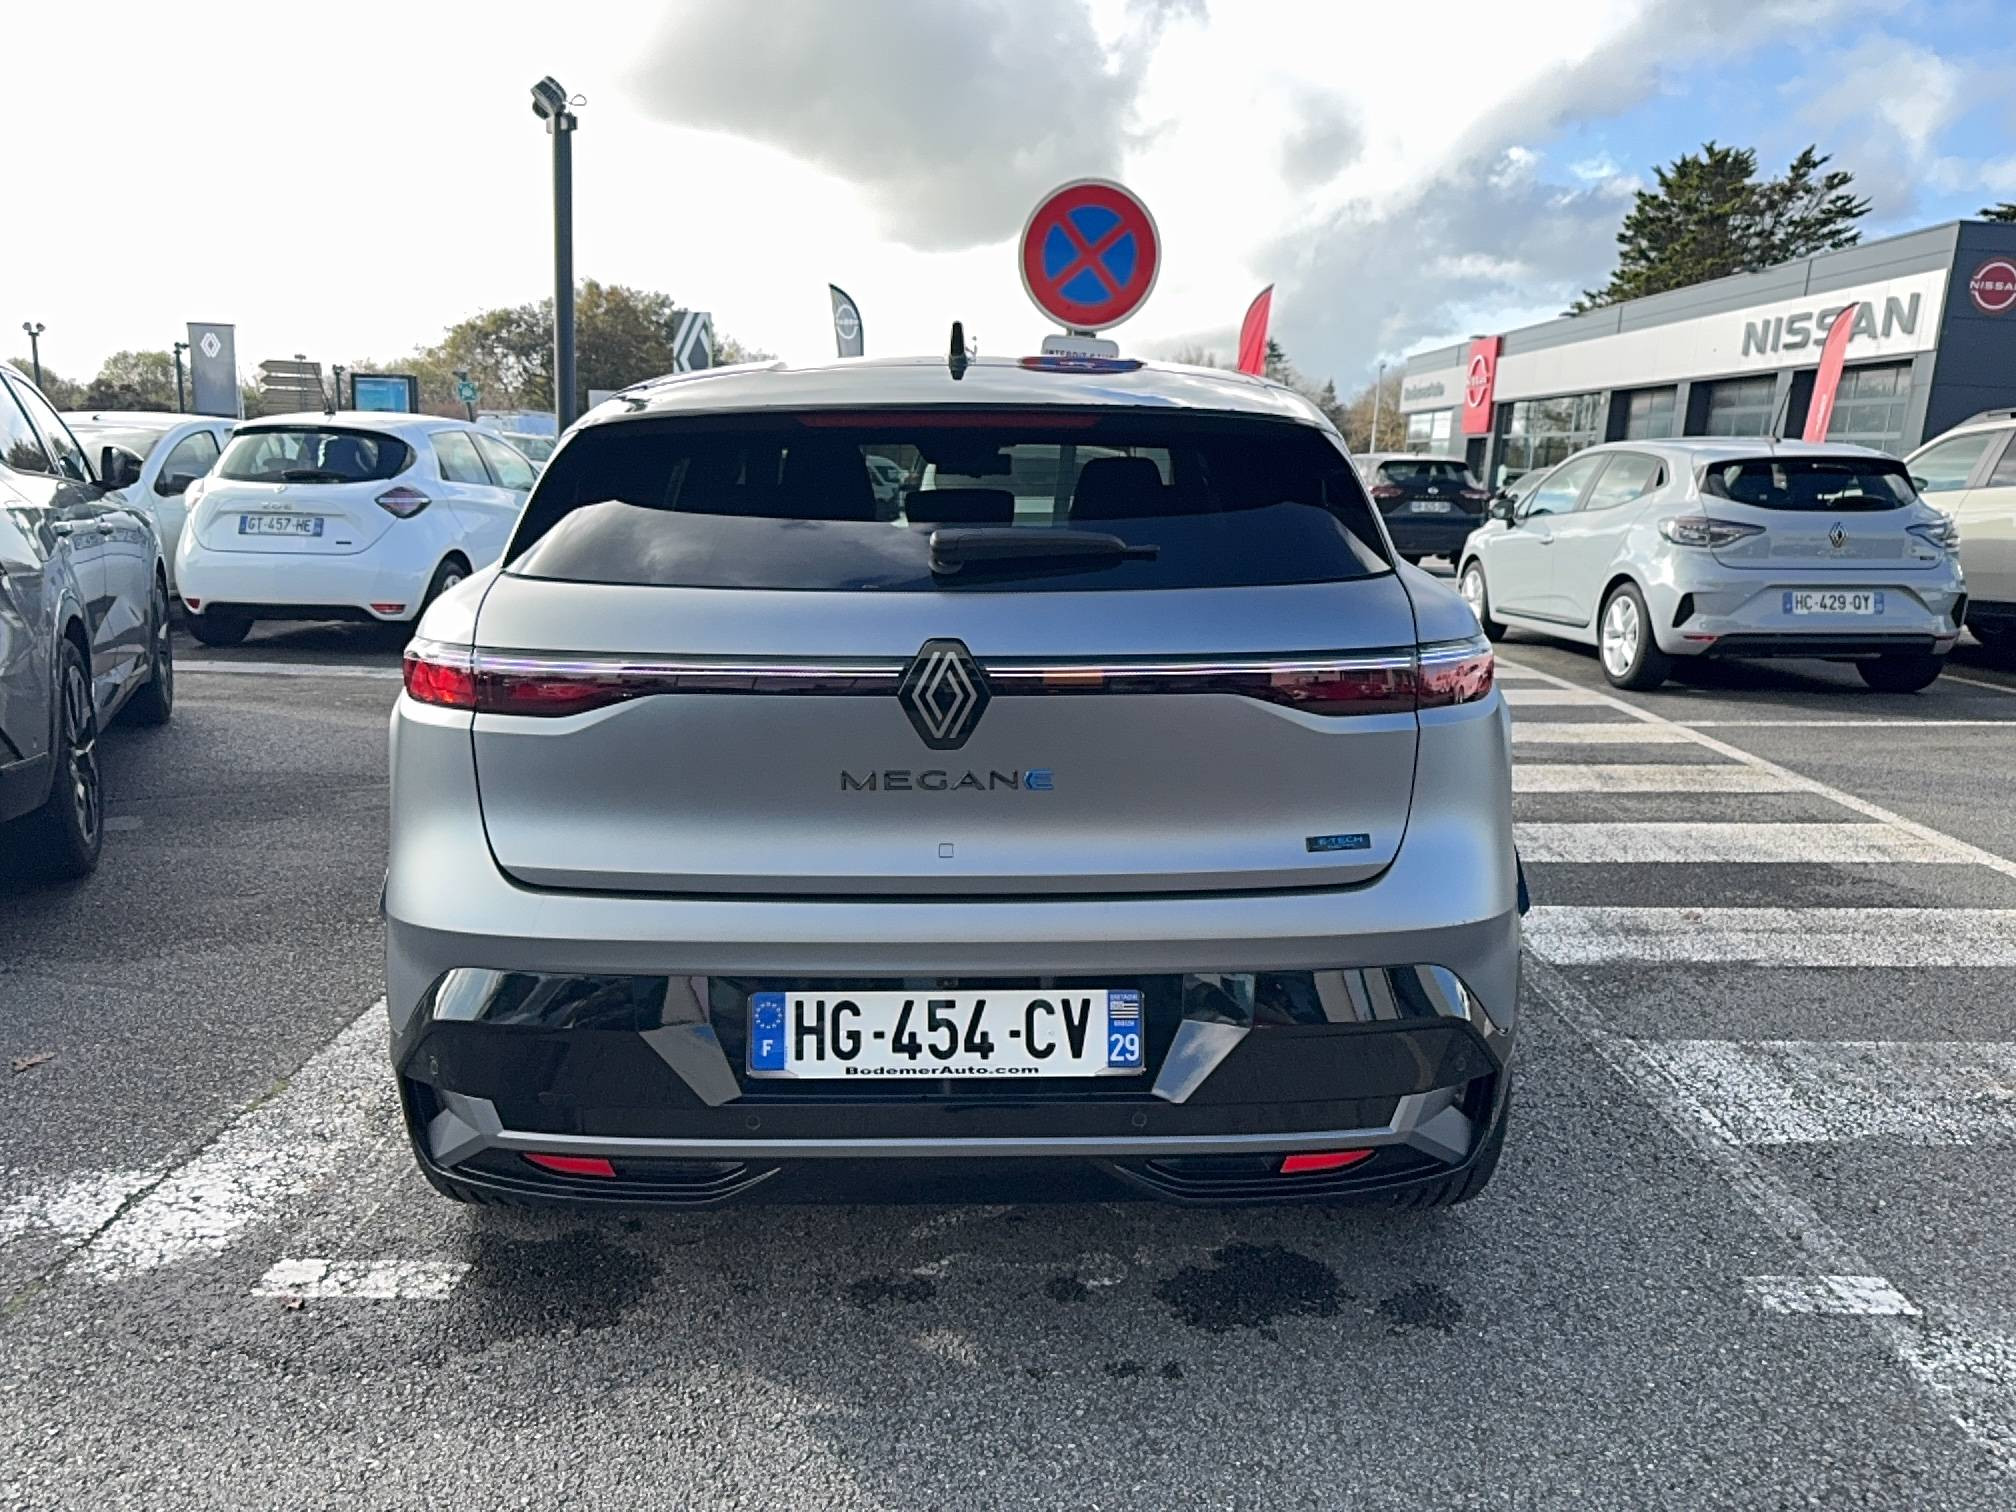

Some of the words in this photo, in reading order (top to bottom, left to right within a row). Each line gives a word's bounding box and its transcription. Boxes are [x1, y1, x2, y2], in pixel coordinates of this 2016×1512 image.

[1970, 280, 2016, 290] NISSA
[1741, 292, 1921, 357] NISSAN
[840, 768, 1055, 791] MEGANE
[794, 998, 1091, 1061] HG-454-CV
[762, 1039, 774, 1057] F
[1109, 1033, 1140, 1062] 29
[845, 1066, 1040, 1076] BodemerAuto.com
